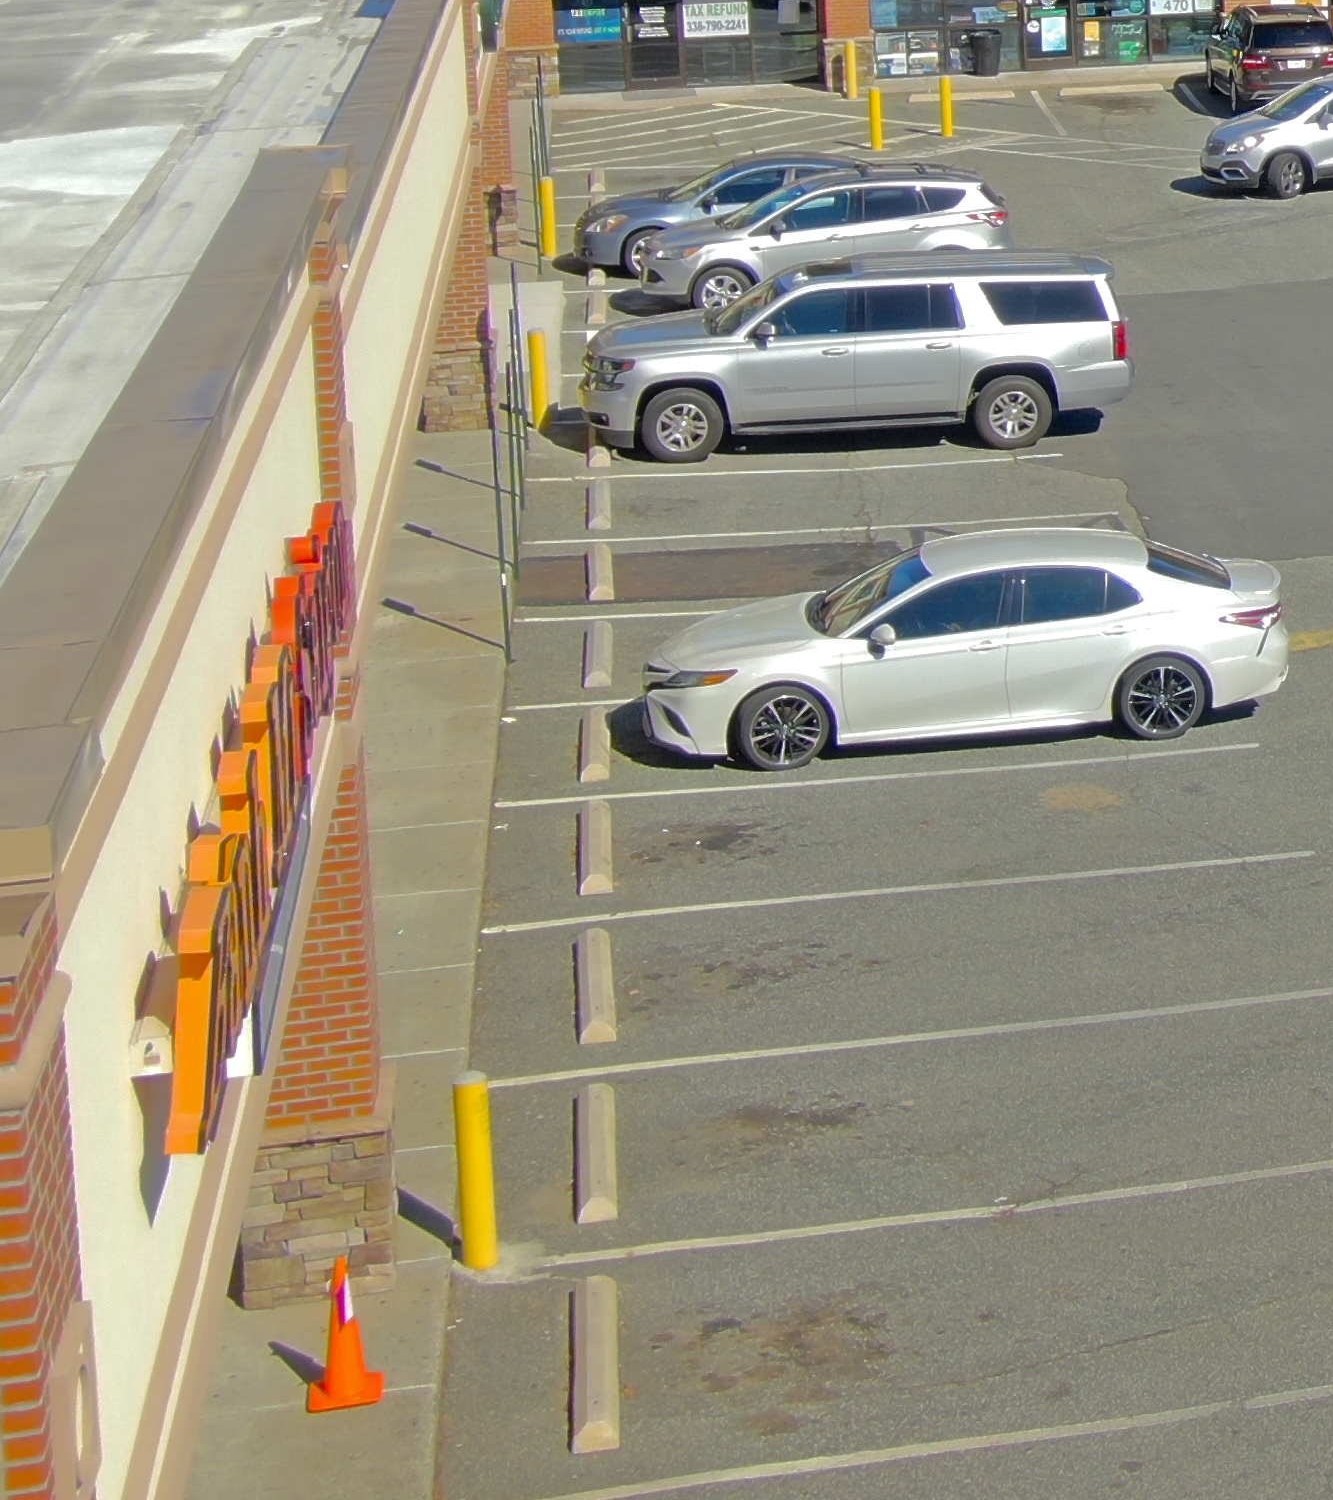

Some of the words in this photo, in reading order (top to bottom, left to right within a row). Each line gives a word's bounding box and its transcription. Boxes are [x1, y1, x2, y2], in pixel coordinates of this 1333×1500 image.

[684, 4, 704, 17] TAX
[706, 3, 747, 16] REFUND
[1163, 0, 1189, 12] 470
